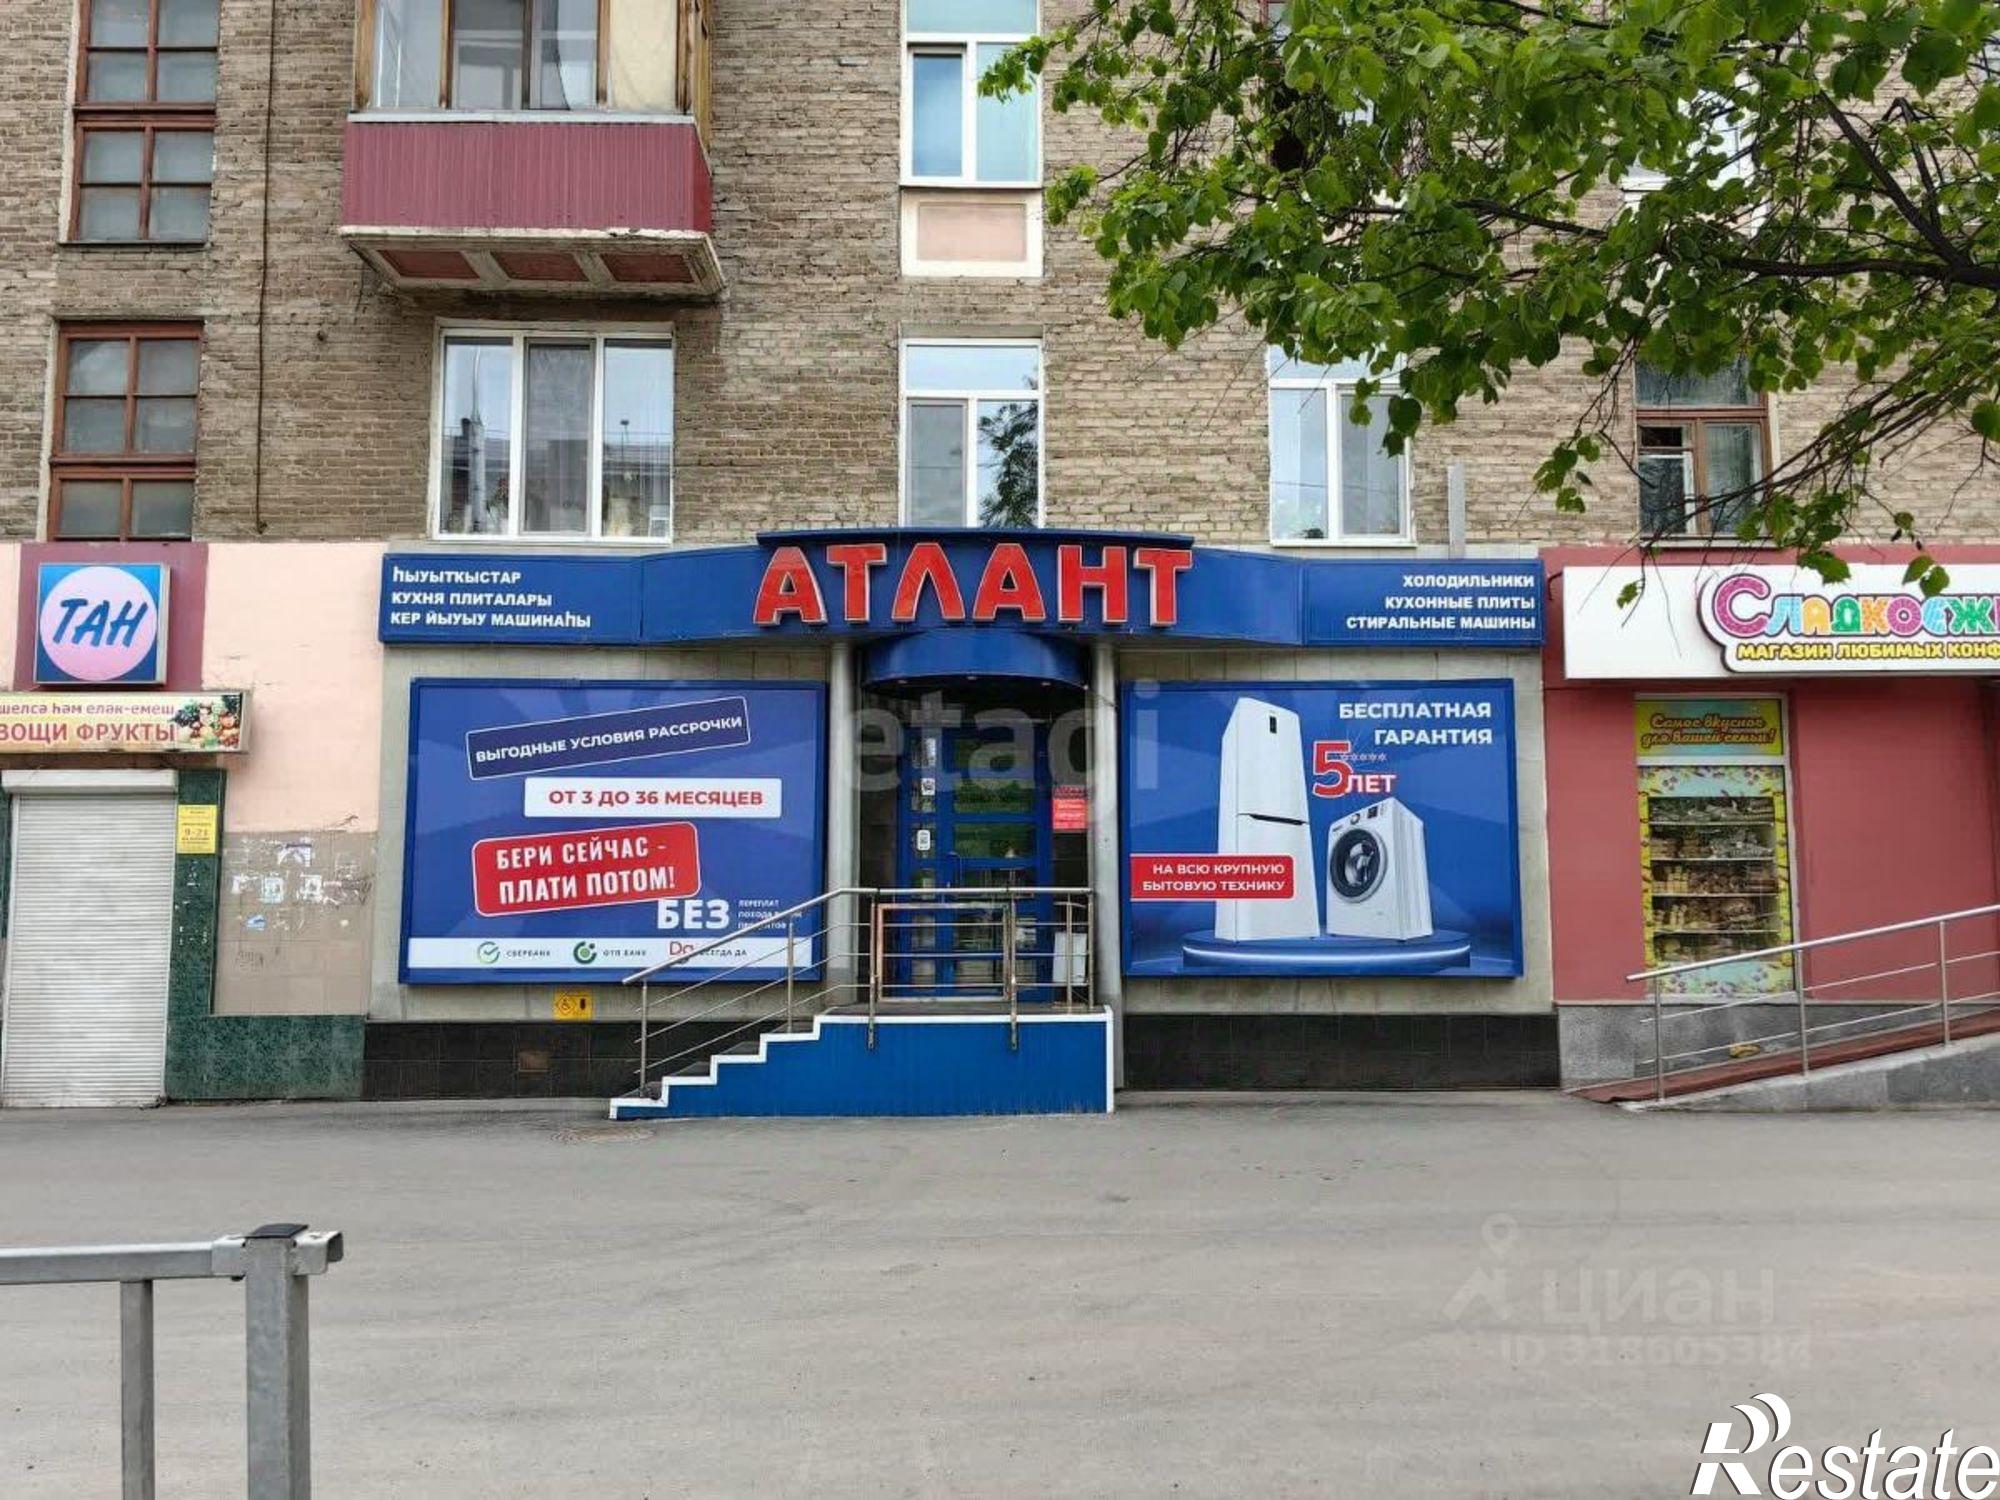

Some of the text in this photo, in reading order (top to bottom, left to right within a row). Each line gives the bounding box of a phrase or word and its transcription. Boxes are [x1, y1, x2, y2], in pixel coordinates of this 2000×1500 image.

[753, 542, 1194, 626] АТЛАНТ
[1403, 575, 1535, 589] ХОЛОДИЛЬНИКИ
[392, 592, 552, 607] КУХНЯ ПЛИТАЛАРЫ
[1385, 597, 1535, 609] КУХОННЫЕ ПЛИТЫ
[53, 598, 148, 647] ТАН
[390, 612, 421, 625] КЕР
[1346, 617, 1535, 630] СТИРАЛЬНЫЕ МАШИНЫ
[1737, 643, 1833, 660] МАГАЗИН
[1837, 643, 1944, 660] ЛЮБИМЫХ
[1339, 703, 1491, 720] БЕСПЛАТНАЯ
[76, 723, 175, 741] ФРУКТЫ
[475, 716, 742, 763] ВЫГОДНЫЕ УСЛОВИЯ РАССРОЧКИ
[1374, 729, 1492, 745] ГАРАНТИЯ
[1312, 741, 1397, 798] 5 ЛЕТ
[549, 791, 763, 807] ОТ 3 ДО 36 МЕСЯЦЕВ
[497, 844, 553, 870] БЕРИ
[562, 836, 649, 865] СЕЙЧАС
[1153, 863, 1285, 876] НА ВСЮ КРУПНУЮ
[499, 866, 676, 905] ПЛАТИ ПОТОМ!
[1142, 880, 1285, 892] БЫТОВУЮ ТЕХНИКУ
[657, 899, 730, 929] БЕЗ
